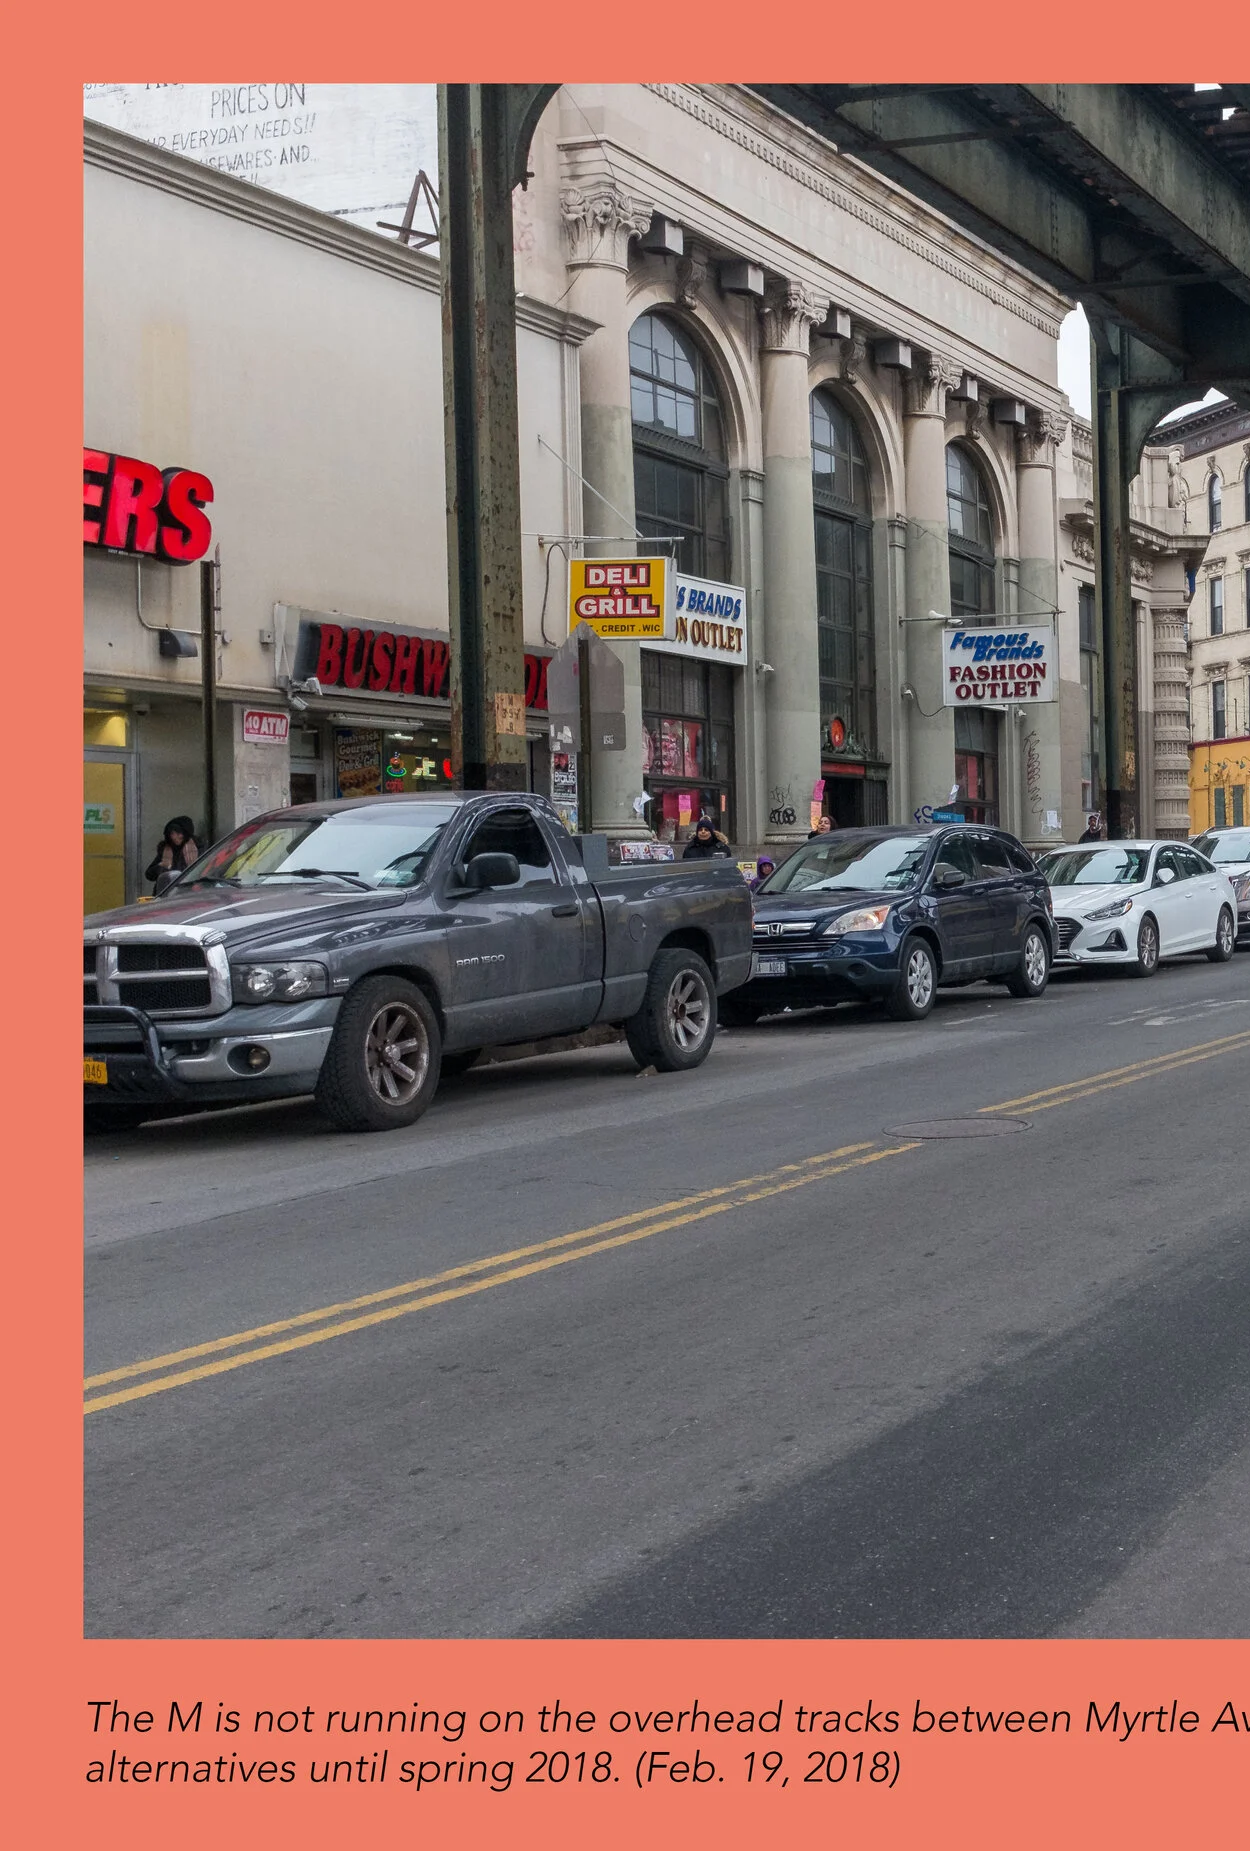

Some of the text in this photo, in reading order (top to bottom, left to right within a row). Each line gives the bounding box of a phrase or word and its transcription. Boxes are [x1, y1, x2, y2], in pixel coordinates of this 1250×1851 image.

[211, 84, 269, 119] PRICES
[171, 124, 249, 151] EVERYDAY
[254, 113, 317, 139] NEEDS!!
[588, 567, 646, 585] DELI
[613, 587, 622, 596] &
[578, 598, 656, 616] GRILL
[686, 589, 743, 622] BRANDS
[601, 624, 635, 633] CREDIT
[690, 619, 743, 654] OUTLET
[949, 631, 1030, 650] Famous
[972, 640, 1046, 662] Brands
[949, 662, 1047, 683] FASHION
[955, 680, 1041, 700] OUTLET
[260, 716, 287, 736] ATM
[456, 954, 505, 968] RAM 1500
